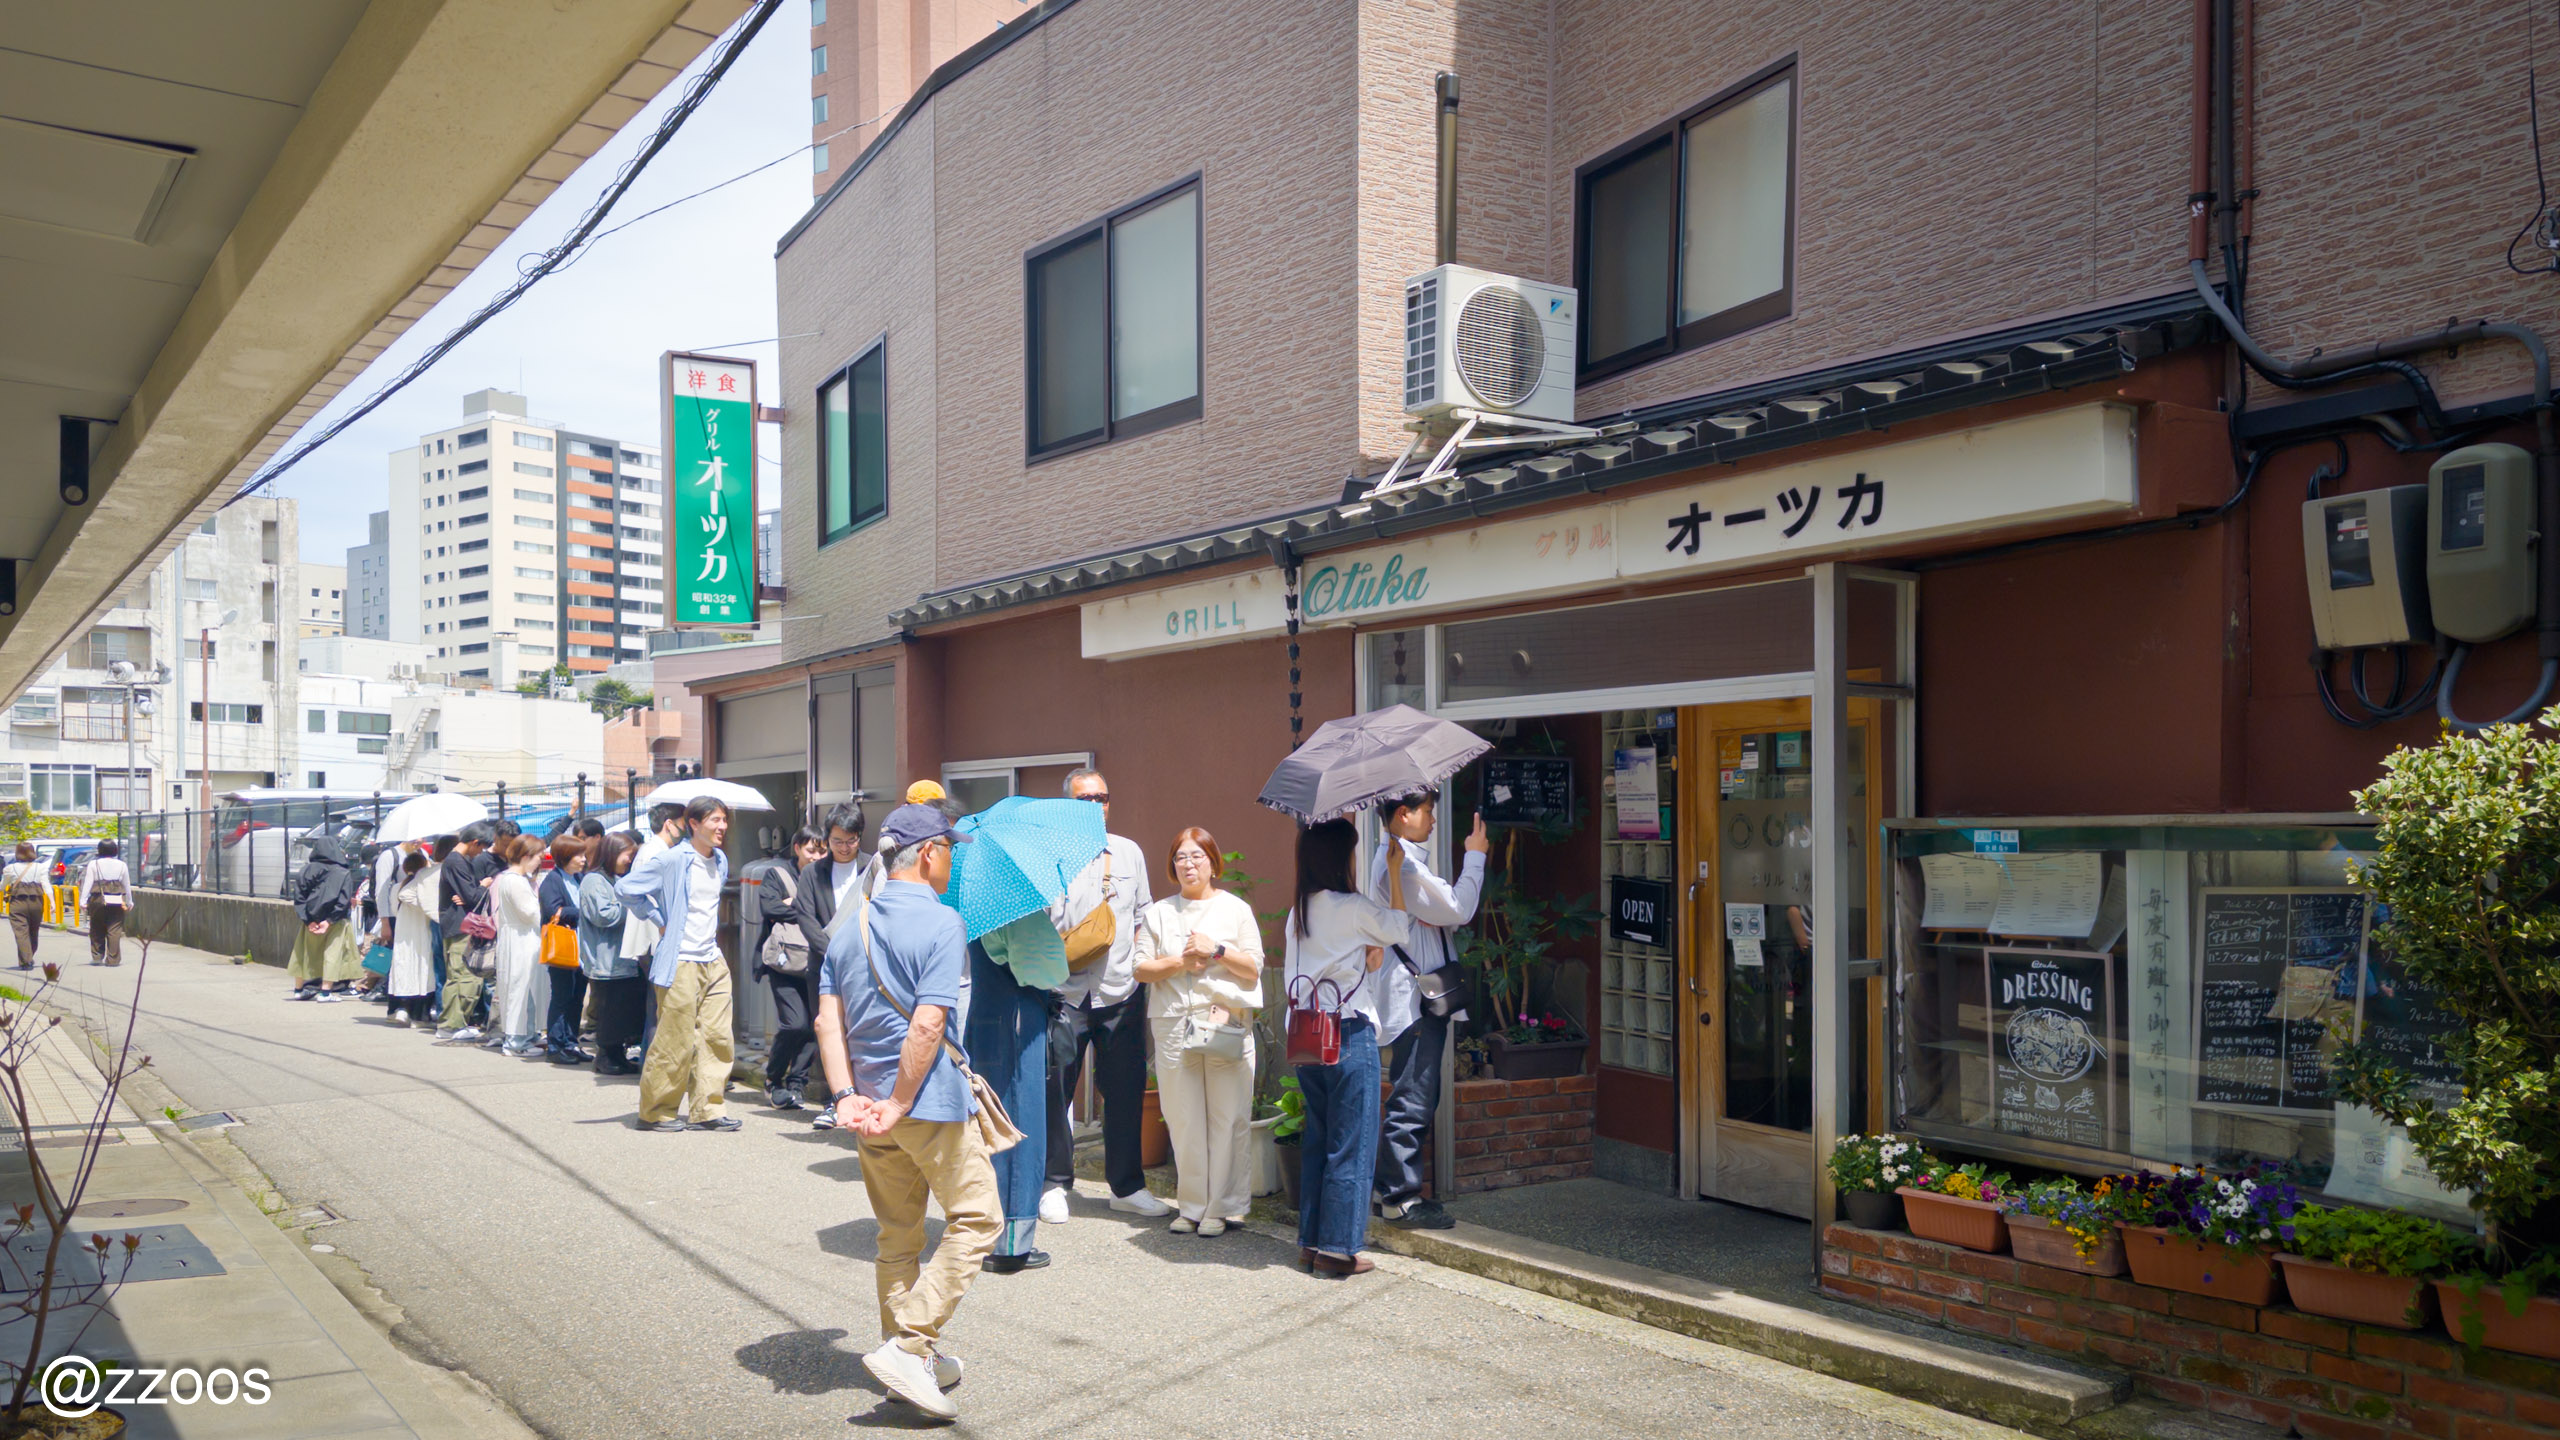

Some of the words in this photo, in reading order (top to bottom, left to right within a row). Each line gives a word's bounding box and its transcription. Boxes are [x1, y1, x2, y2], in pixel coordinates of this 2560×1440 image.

[687, 368, 737, 394] 洋食
[705, 407, 721, 451] グリル
[695, 455, 729, 584] オーツカ
[1535, 521, 1611, 559] グリル
[1664, 472, 1885, 556] オーツカ
[691, 592, 737, 604] 昭和32年
[1302, 553, 1431, 618] Otuka
[699, 604, 731, 616] 創業
[1166, 600, 1246, 637] GRILL
[1622, 898, 1654, 924] OPEN
[2002, 971, 2093, 1012] DRESSING
[2141, 887, 2171, 1122] 毎度有難う御座います
